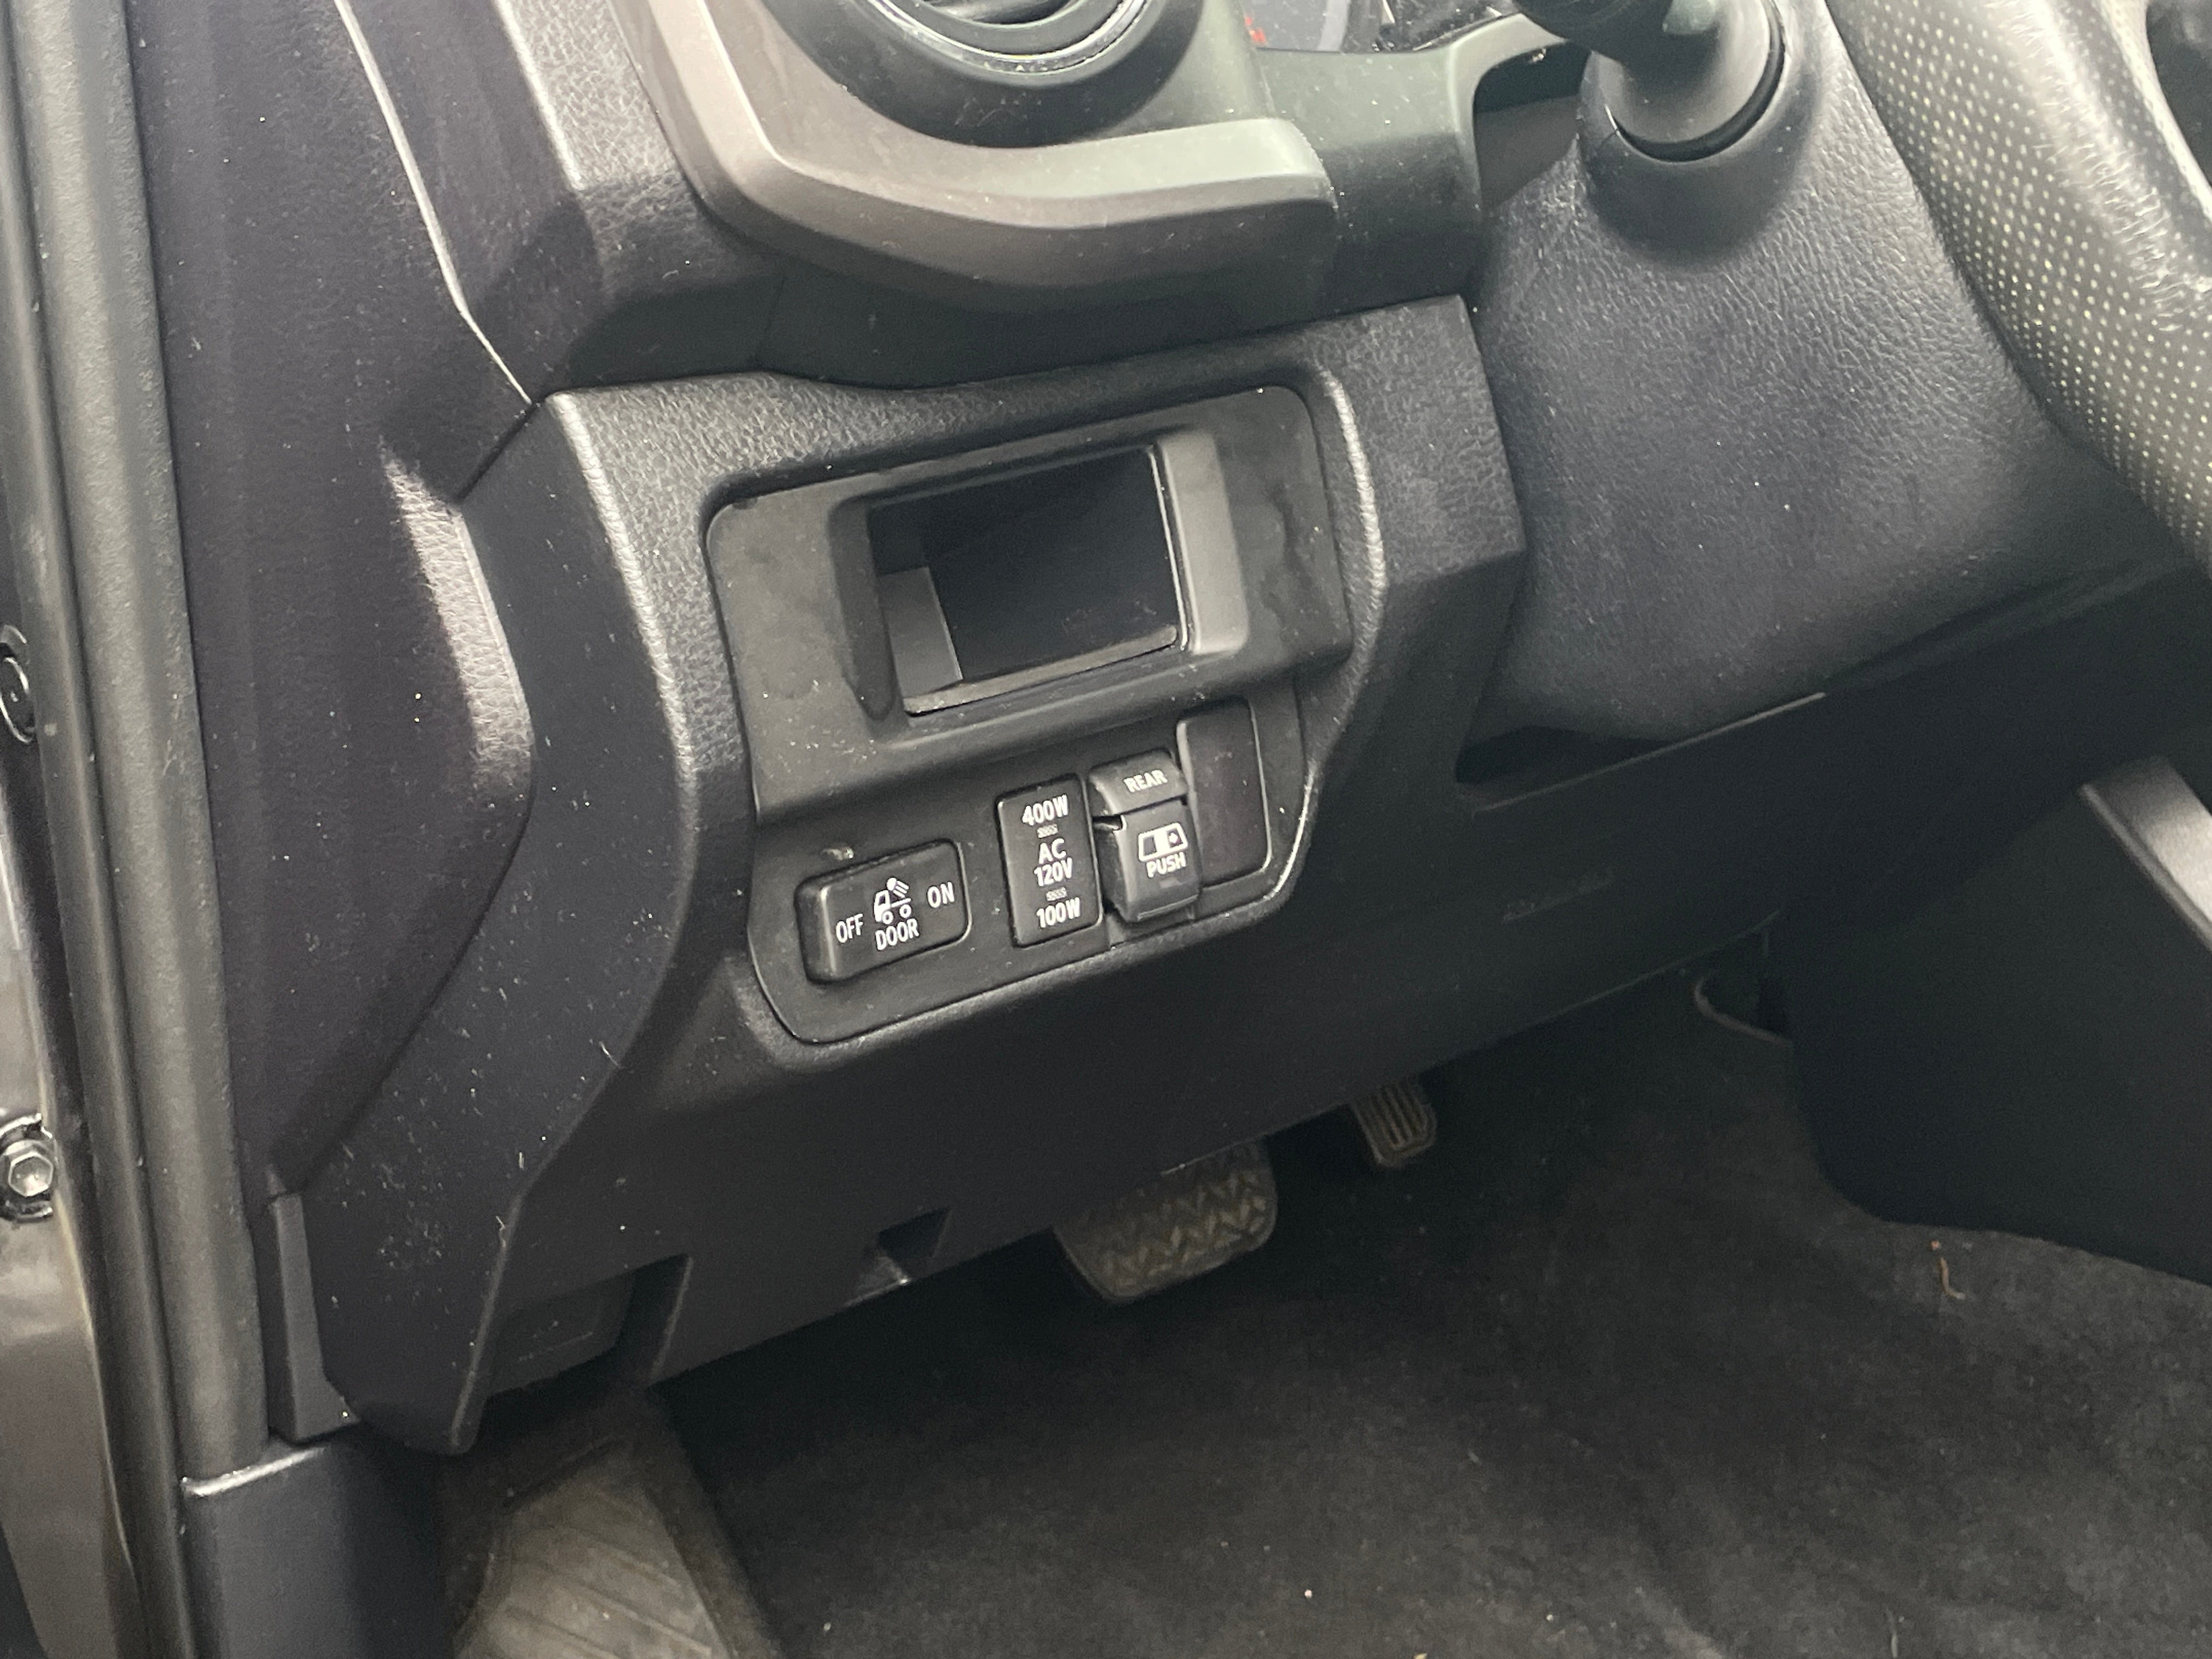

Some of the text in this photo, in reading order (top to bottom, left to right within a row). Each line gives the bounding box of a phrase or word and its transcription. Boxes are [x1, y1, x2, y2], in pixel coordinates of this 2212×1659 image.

[1124, 769, 1167, 793] REAR
[1022, 794, 1069, 826] 400W
[1039, 838, 1066, 865] AC
[1146, 851, 1187, 878] PUSH
[1034, 857, 1073, 887] 120V
[927, 881, 955, 908] ON
[836, 913, 864, 943] OFF
[1036, 898, 1081, 929] 100W
[875, 918, 919, 951] DOOR
